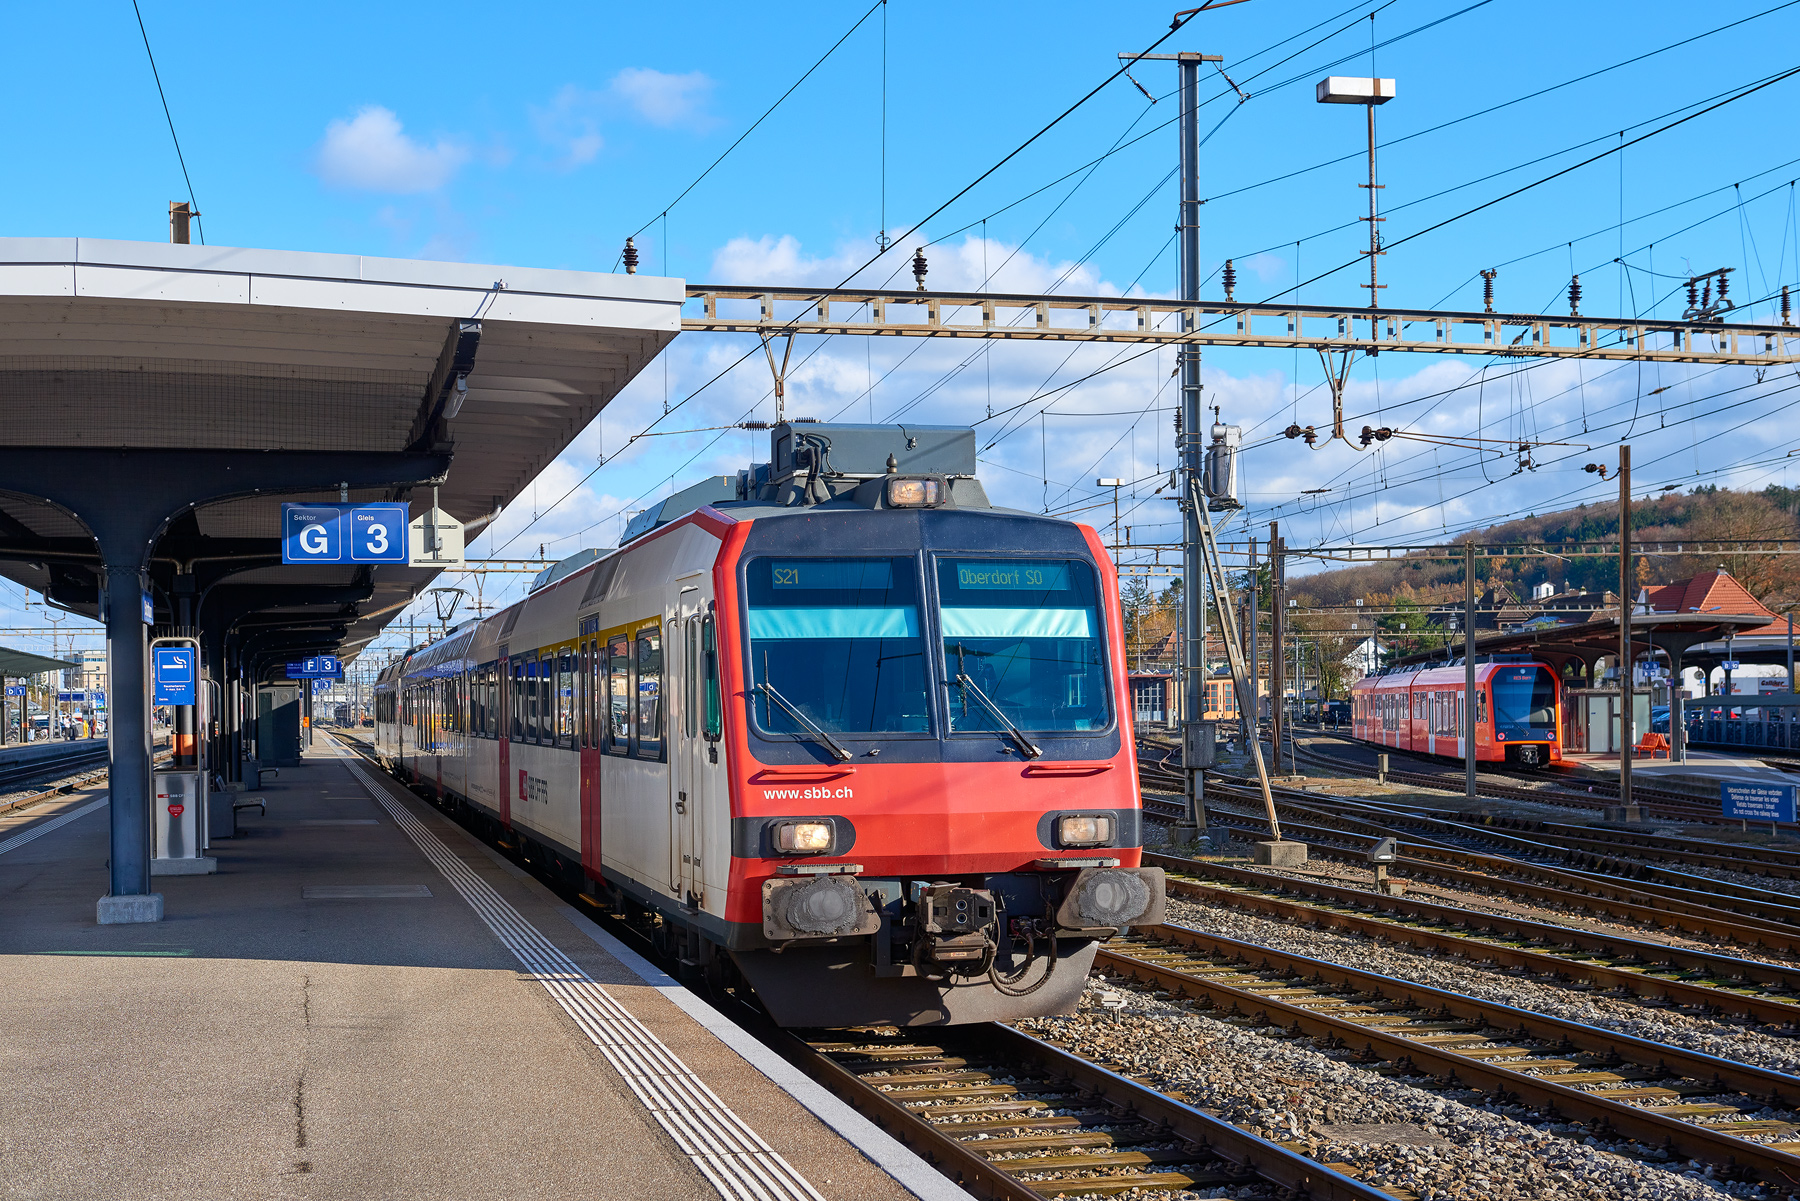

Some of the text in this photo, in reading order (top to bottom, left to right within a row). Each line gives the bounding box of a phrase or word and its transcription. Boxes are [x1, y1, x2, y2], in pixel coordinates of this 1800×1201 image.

[299, 523, 328, 555] G
[366, 523, 389, 554] 3
[774, 568, 799, 585] S21
[959, 569, 1020, 585] Oberdorf
[307, 661, 315, 671] F
[324, 660, 332, 670] 3
[763, 786, 853, 800] www.sbb.ch
[1757, 788, 1768, 796] Gleise
[1732, 807, 1739, 815] Do
[1760, 810, 1771, 818] railway
